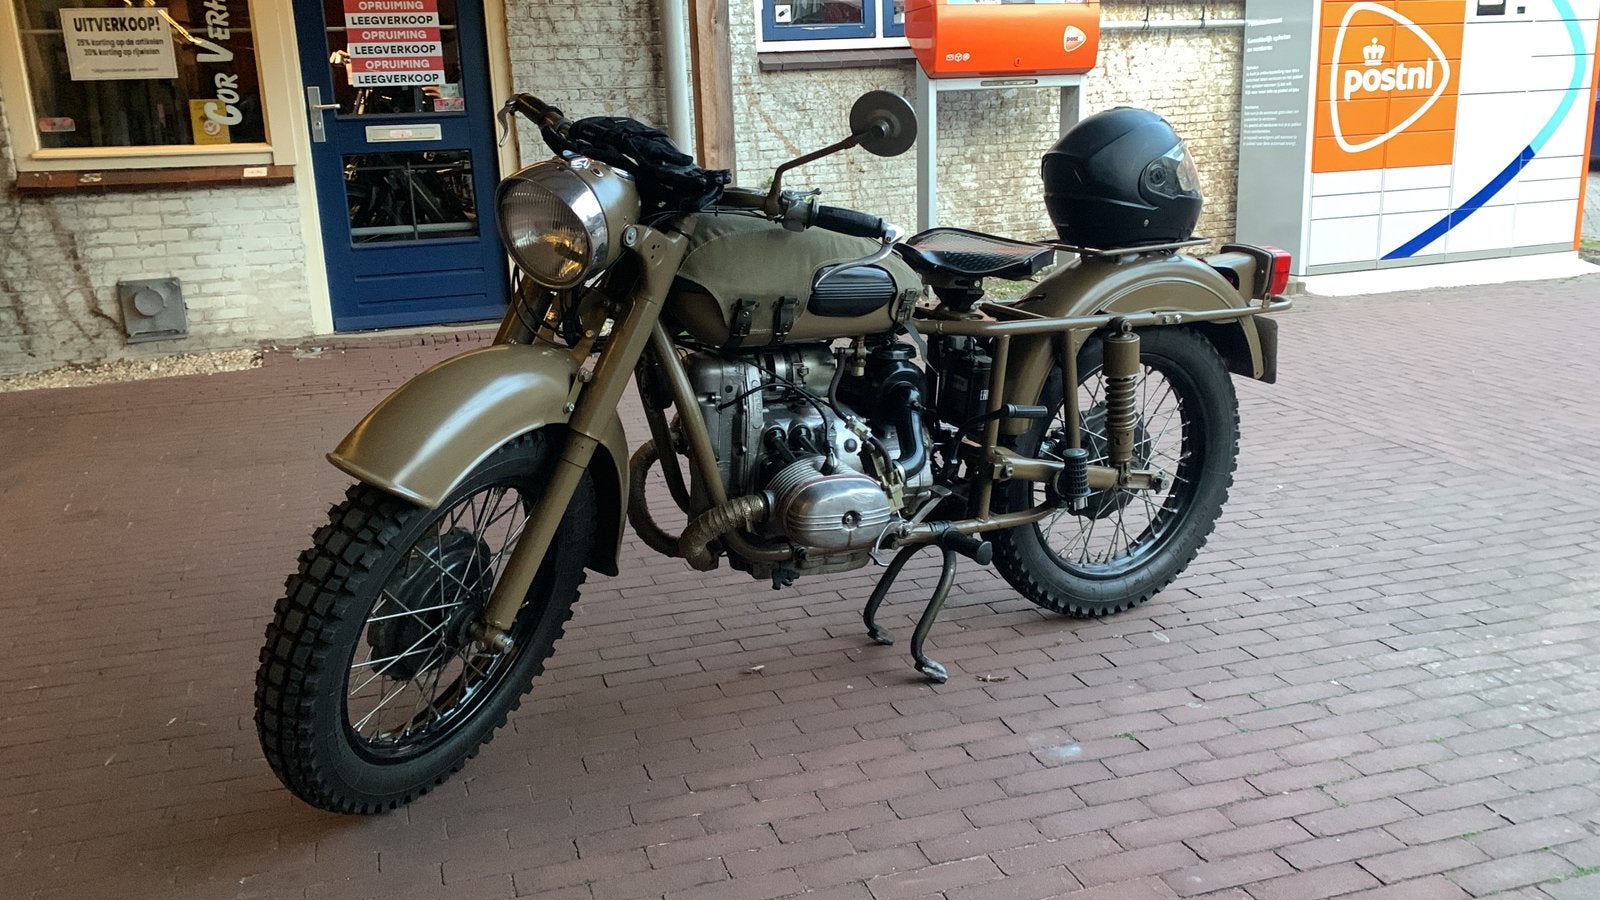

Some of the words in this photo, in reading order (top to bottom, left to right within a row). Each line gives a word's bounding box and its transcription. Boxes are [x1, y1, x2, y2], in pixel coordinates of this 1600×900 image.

[359, 0, 424, 10] OPRUIMING
[73, 16, 160, 32] UITVERKOOP!
[351, 15, 433, 26] LEEGVERKOOP
[362, 30, 427, 40] OPRUIMING
[92, 39, 115, 48] korting
[99, 49, 122, 58] korting
[123, 49, 132, 57] op
[354, 44, 436, 55] LEEGVERKOOP
[365, 59, 430, 70] OPRUIMING
[358, 73, 439, 84] LEEGVERKOOP
[1344, 57, 1434, 102] postnl
